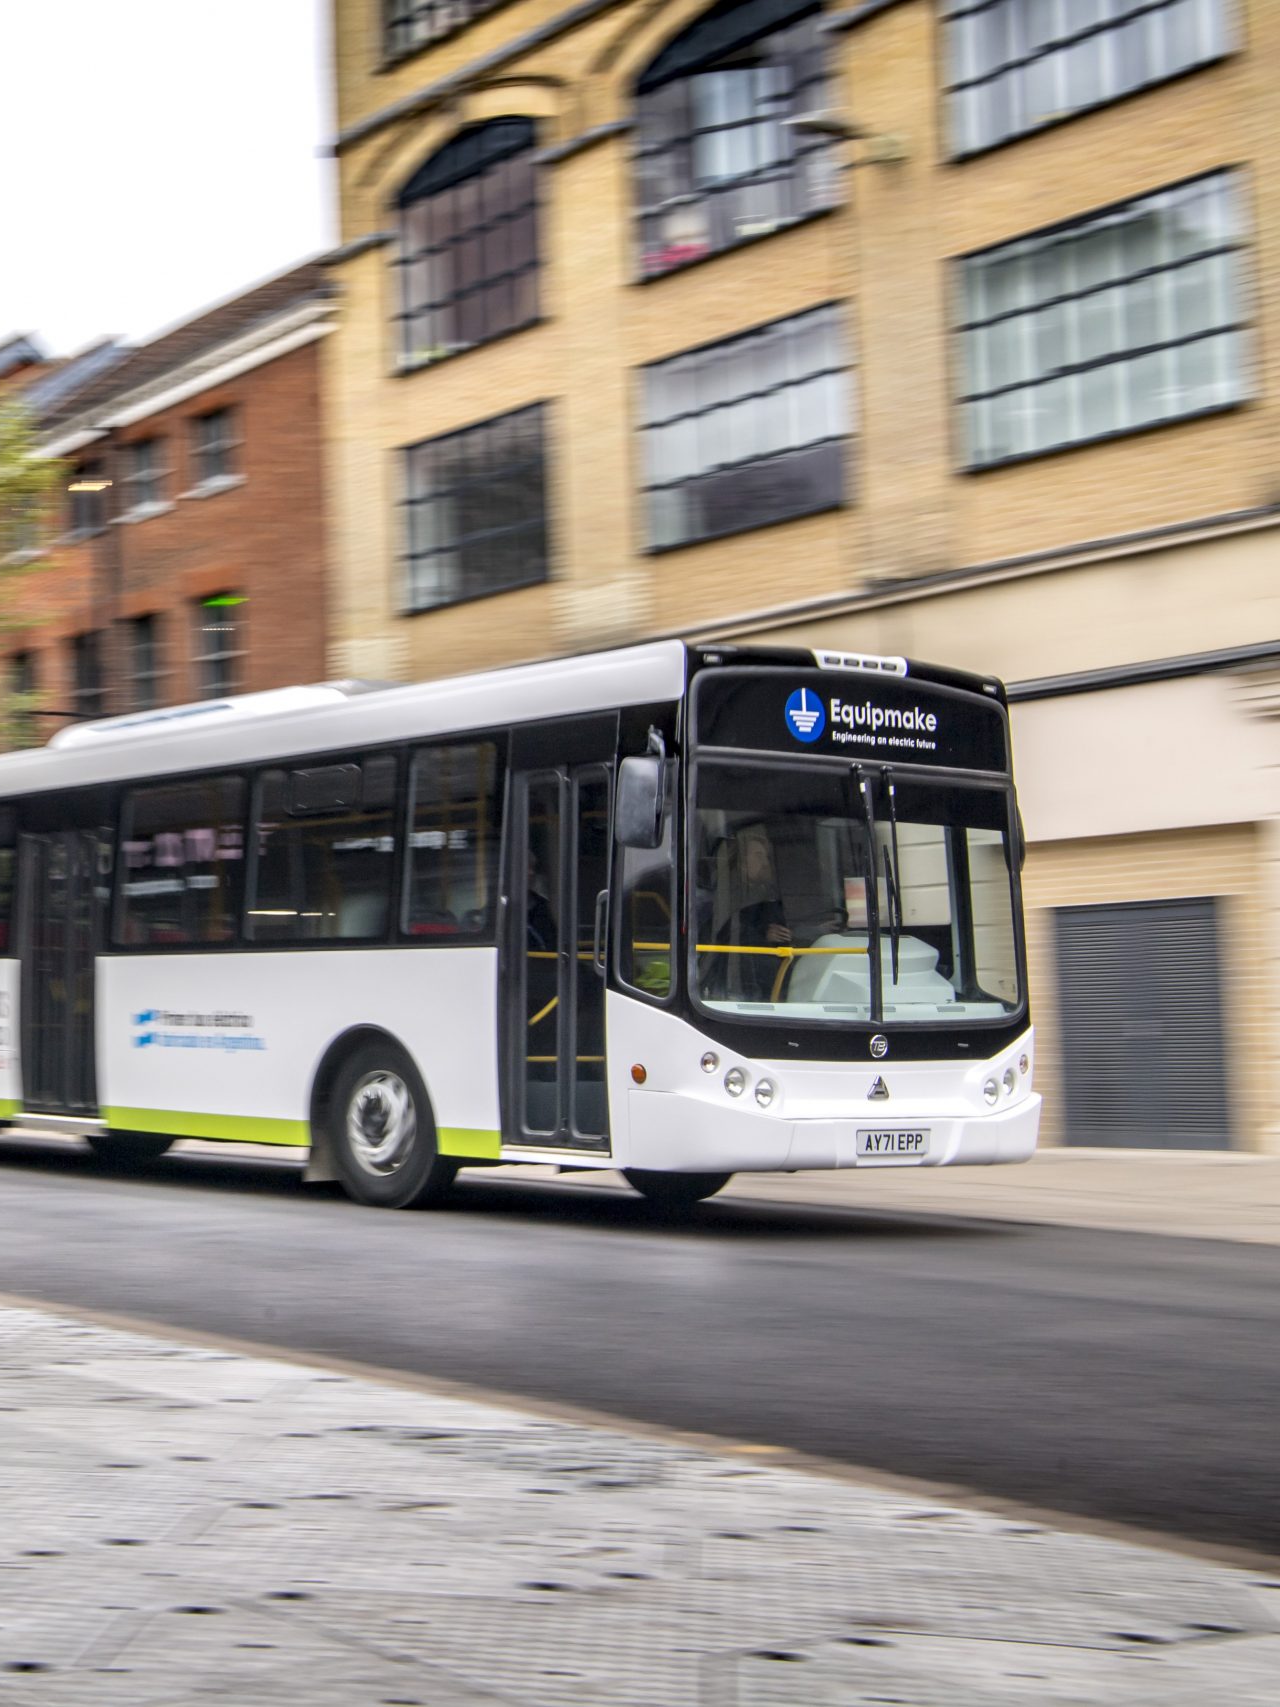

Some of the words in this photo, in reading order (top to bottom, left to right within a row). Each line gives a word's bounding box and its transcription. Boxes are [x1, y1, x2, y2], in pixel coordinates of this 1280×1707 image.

[830, 698, 937, 732] Equipmake
[832, 730, 876, 746] Engineering
[877, 736, 887, 745] an
[888, 736, 915, 748] electric
[916, 738, 936, 750] future
[865, 1133, 895, 1151] AY71
[898, 1133, 923, 1151] EPP
